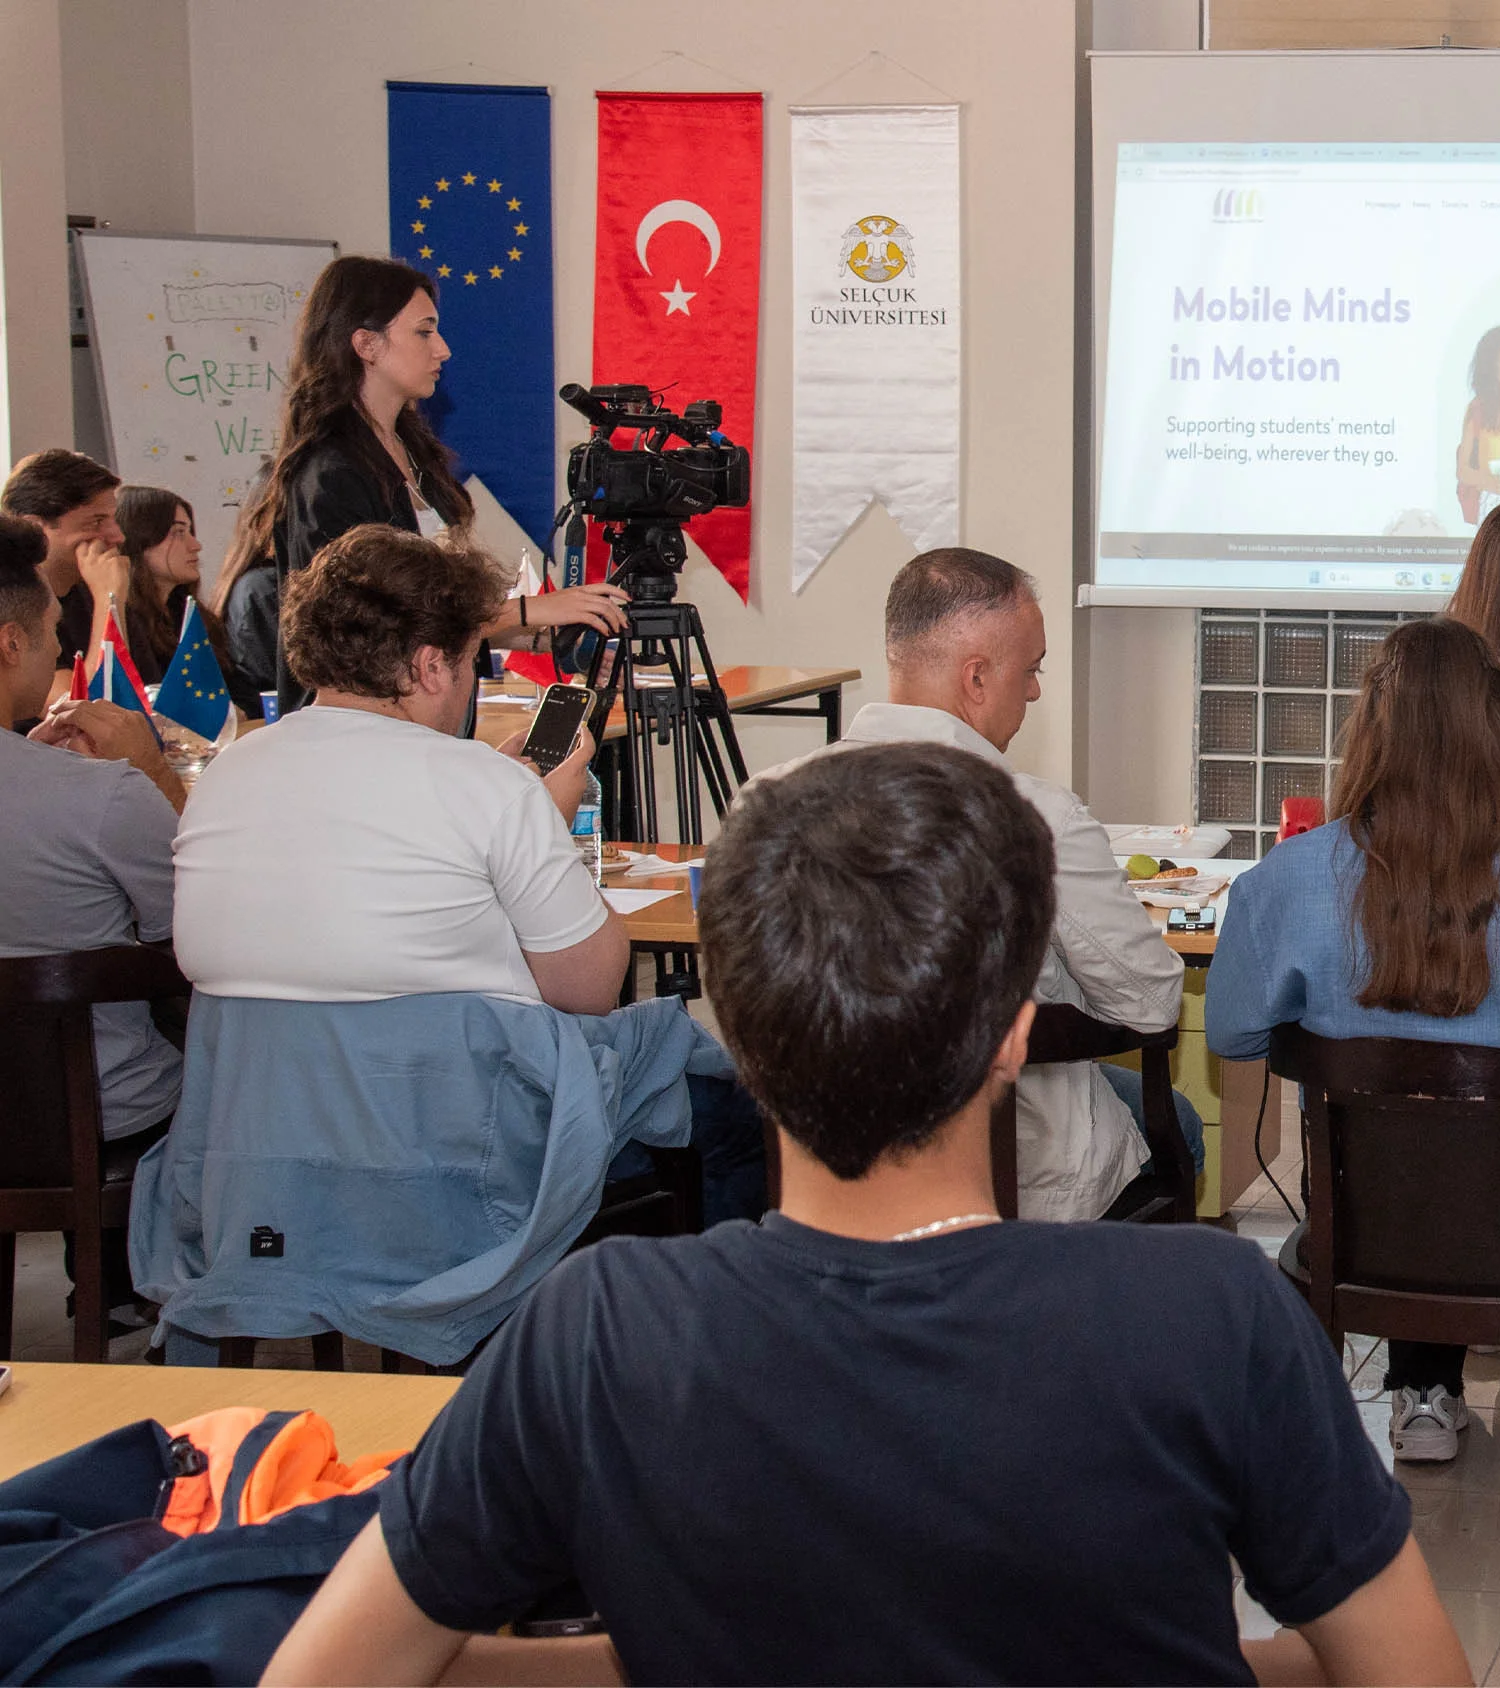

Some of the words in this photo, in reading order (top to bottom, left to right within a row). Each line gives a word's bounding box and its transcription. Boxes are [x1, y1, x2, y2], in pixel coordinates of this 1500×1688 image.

[840, 288, 917, 306] SELÇUK
[1173, 286, 1292, 322] Mobile
[1303, 286, 1411, 323] Minds
[811, 307, 946, 325] ÜNİVERSİTESİ
[1170, 344, 1200, 381] in
[1213, 345, 1341, 382] Motion
[1167, 416, 1255, 437] Supporting
[1260, 417, 1334, 434] students'
[1338, 418, 1395, 435] mental
[1166, 442, 1252, 464] well-being,
[1256, 444, 1330, 461] wherever
[1334, 445, 1369, 466] they
[1374, 449, 1398, 467] go.
[569, 555, 579, 587] SON
